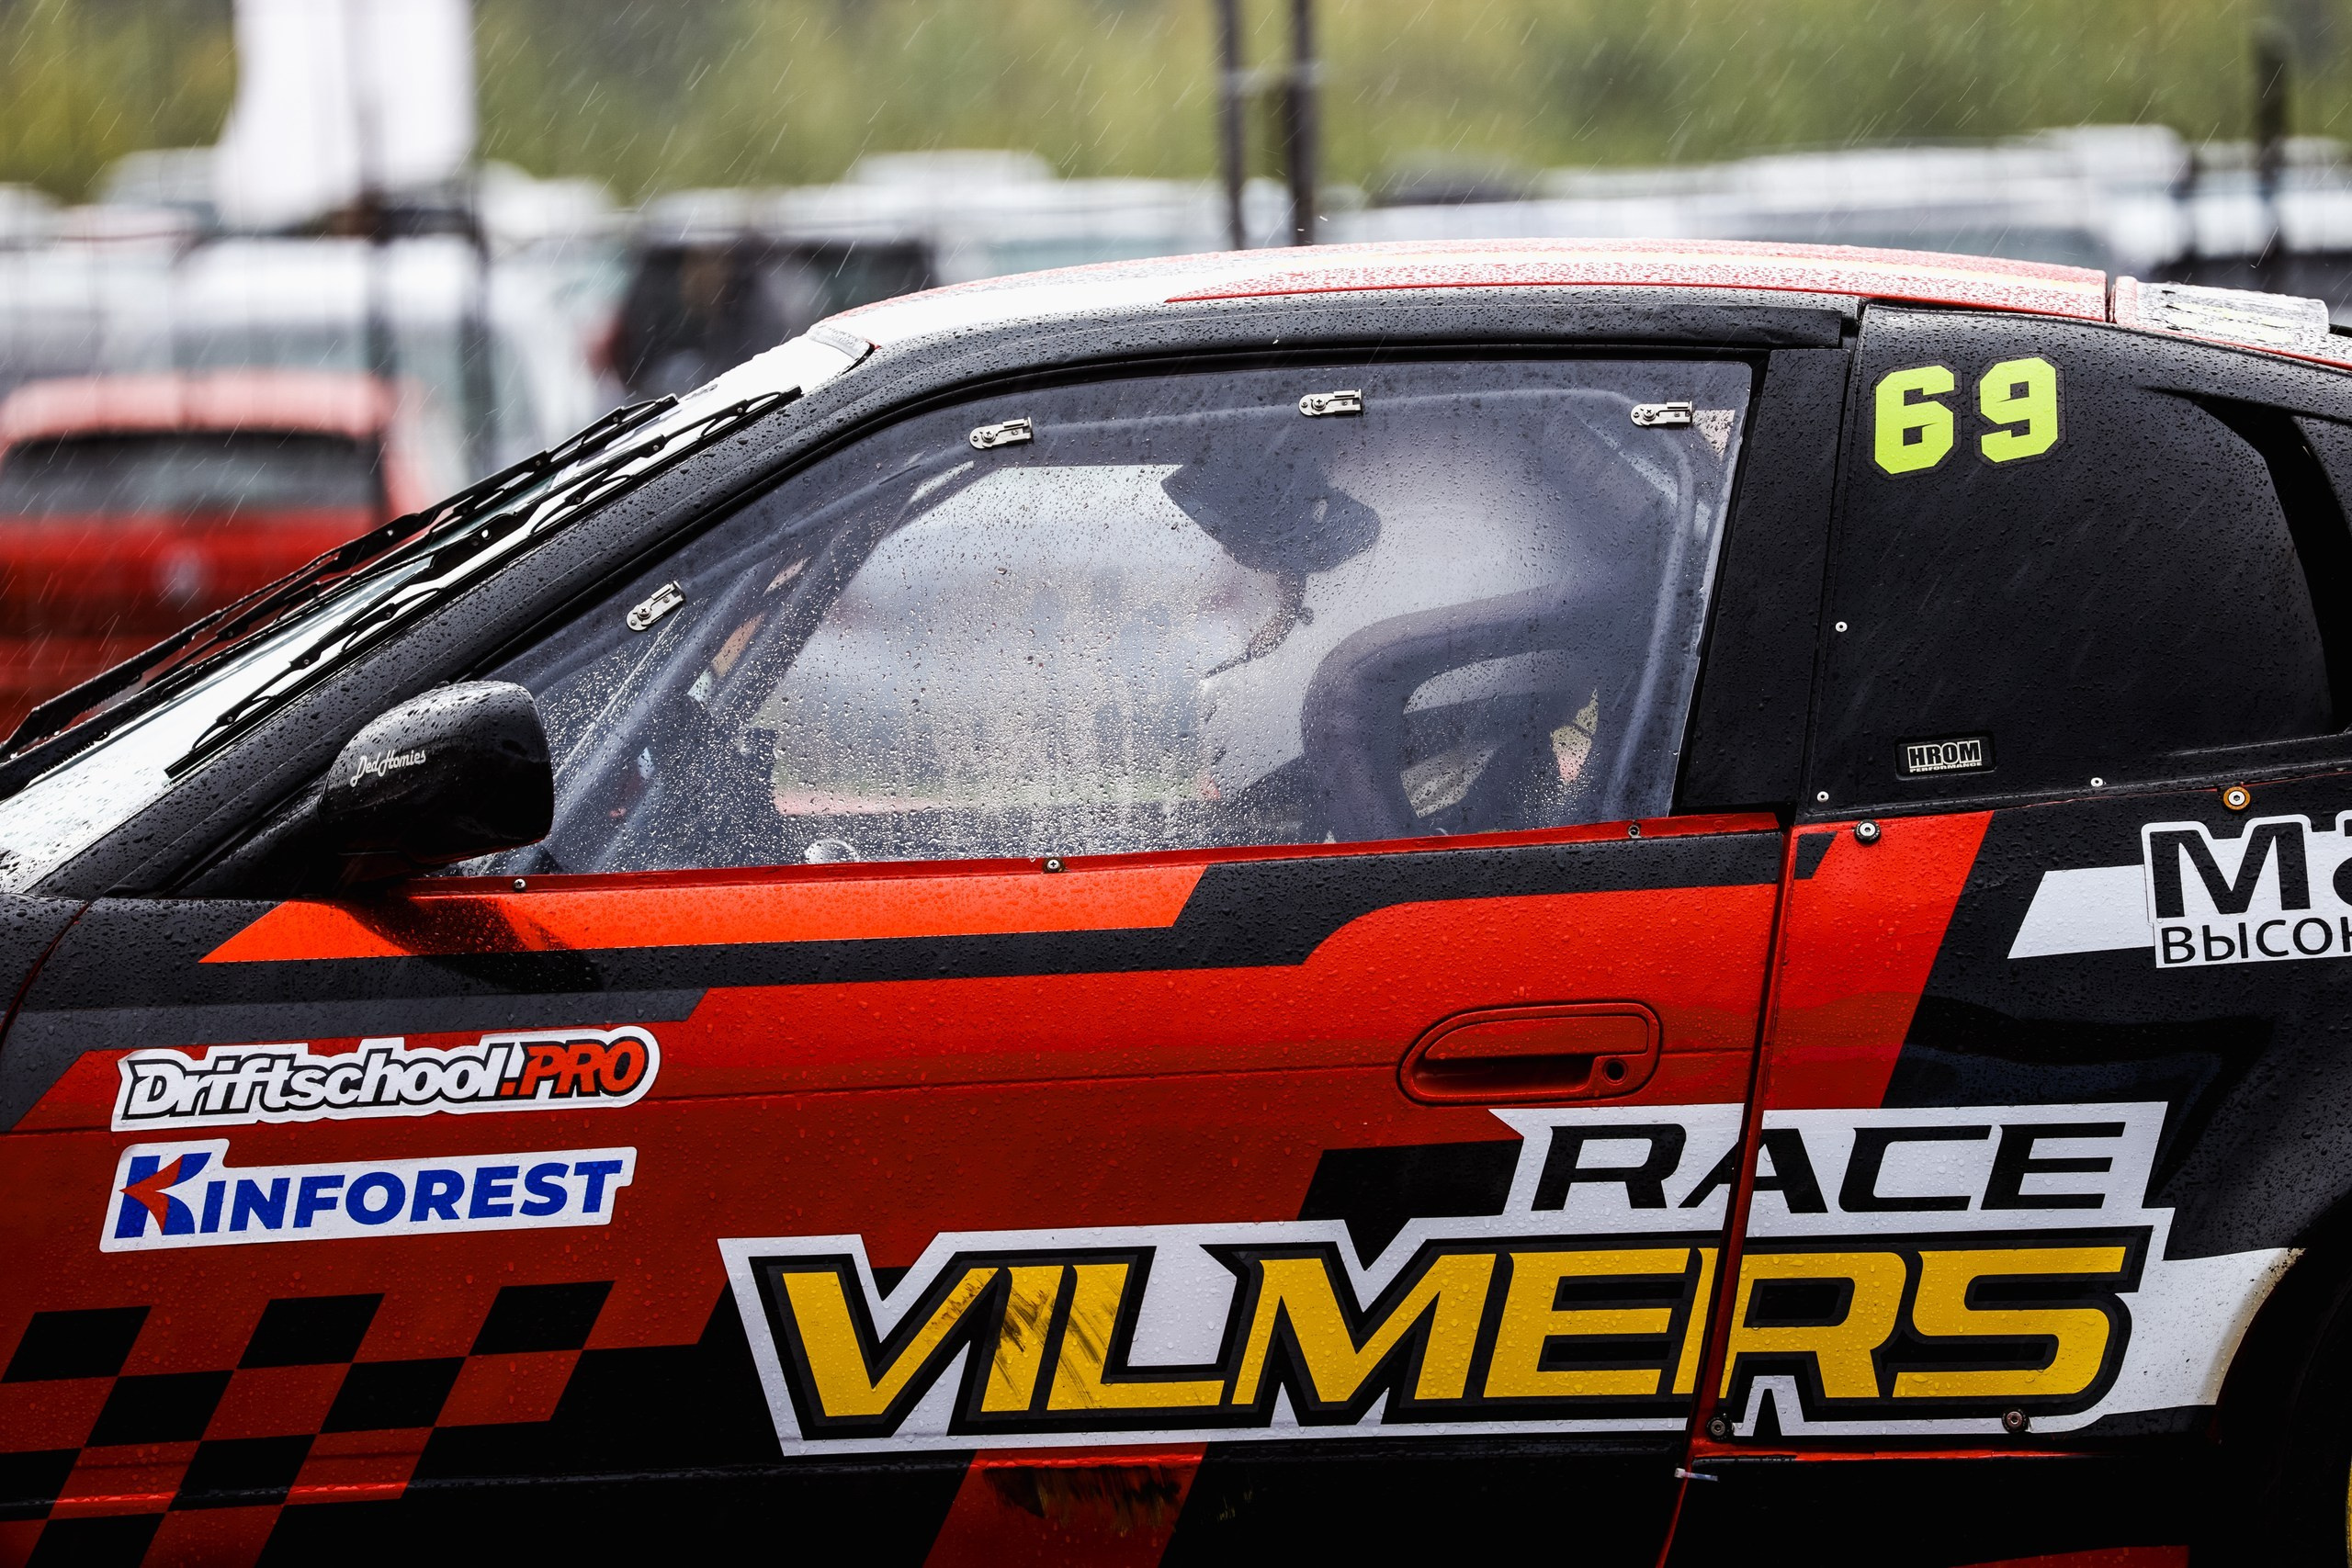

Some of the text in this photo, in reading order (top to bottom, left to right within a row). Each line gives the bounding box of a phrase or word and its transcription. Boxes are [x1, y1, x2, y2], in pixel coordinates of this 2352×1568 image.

[1874, 356, 2059, 475] 69
[1907, 740, 1982, 768] HROM
[1909, 761, 1983, 773] PERFORMANCE
[121, 1036, 649, 1120] Driftschool.PRO
[113, 1152, 622, 1239] KINFOREST
[1532, 1122, 2125, 1213] RACE
[770, 1240, 2132, 1421] VILMERS
